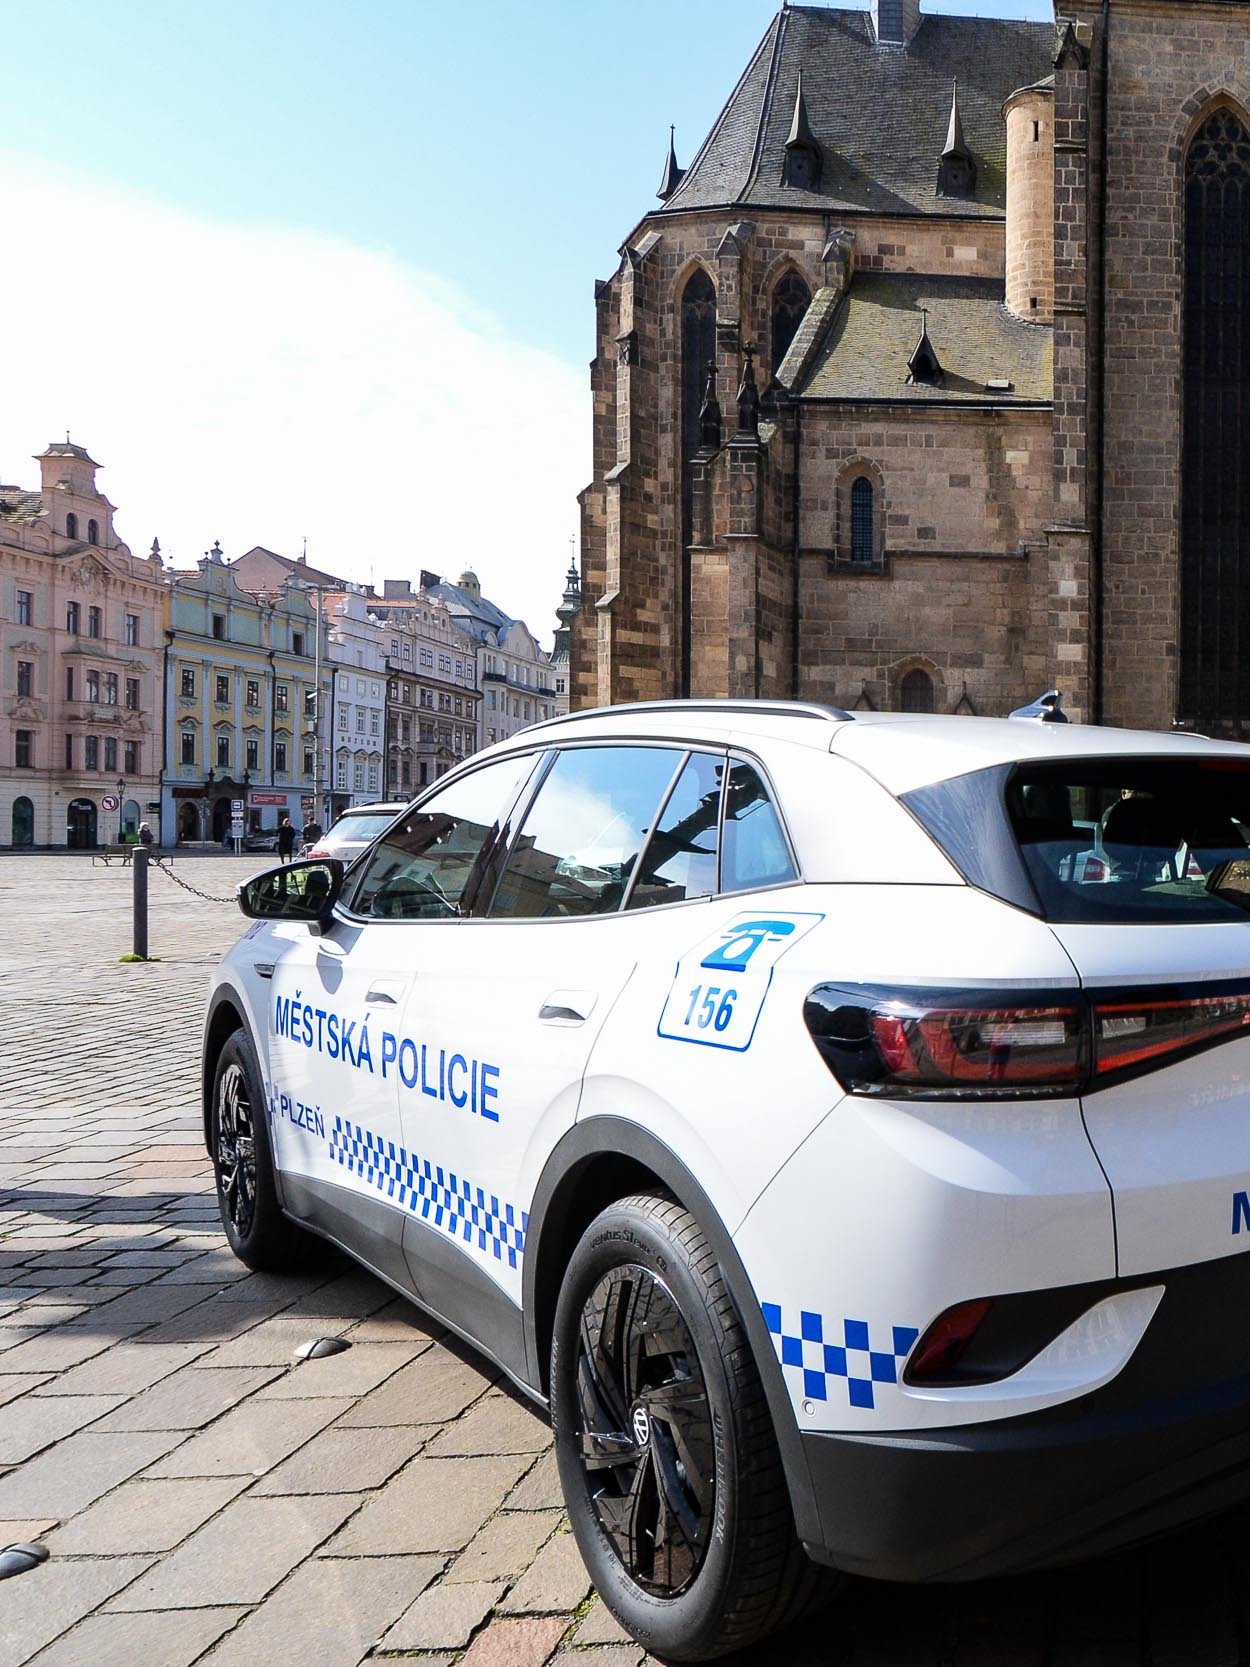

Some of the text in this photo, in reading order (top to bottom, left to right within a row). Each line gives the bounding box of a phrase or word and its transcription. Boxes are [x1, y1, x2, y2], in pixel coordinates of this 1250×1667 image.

[684, 984, 738, 1032] 156
[275, 989, 500, 1123] MĚSTSKÁ POLICIE
[280, 1094, 326, 1139] PLZEŇ
